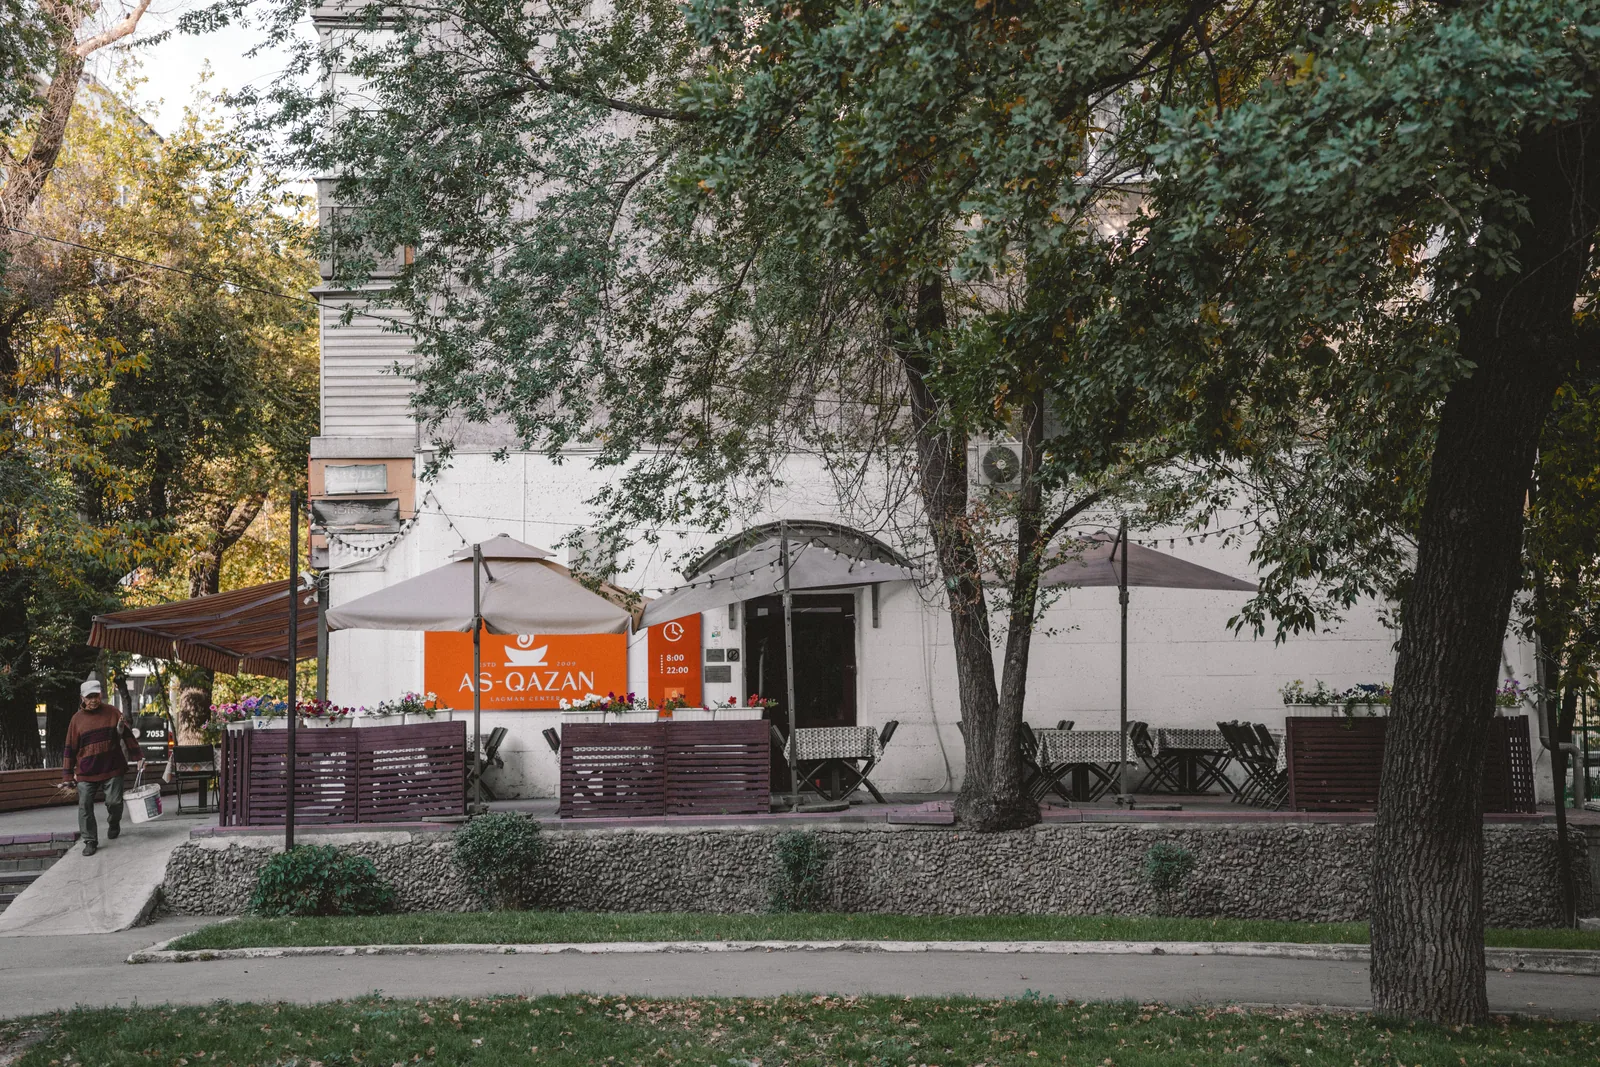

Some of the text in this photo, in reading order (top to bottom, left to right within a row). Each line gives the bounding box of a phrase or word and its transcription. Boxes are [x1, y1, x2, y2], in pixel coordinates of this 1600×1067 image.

[666, 654, 684, 662] 8:00
[666, 666, 689, 674] 22:00
[458, 671, 595, 692] AS-QAZAN
[146, 730, 165, 738] 7053
